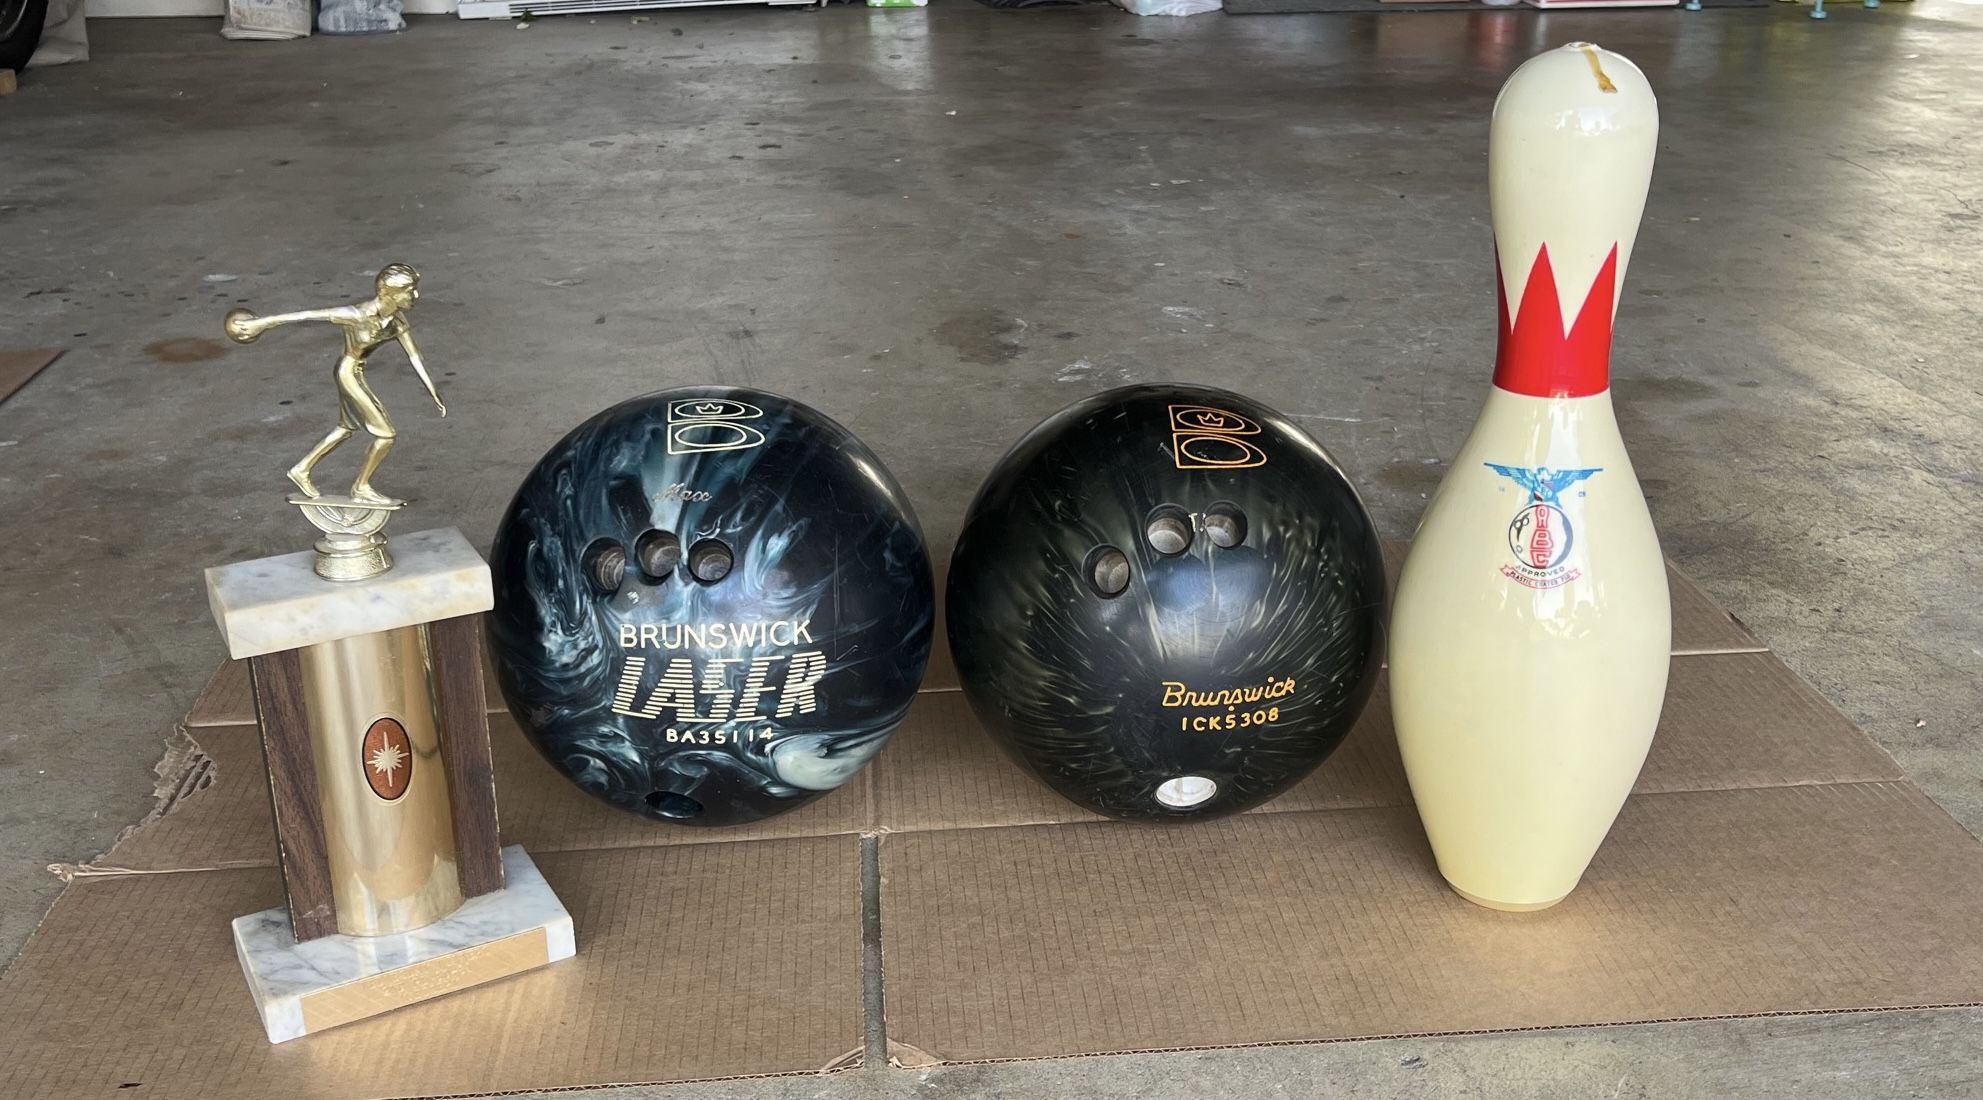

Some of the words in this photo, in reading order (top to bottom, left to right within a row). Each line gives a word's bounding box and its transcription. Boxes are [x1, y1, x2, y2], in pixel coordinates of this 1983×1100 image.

[1516, 565, 1565, 577] APPROVED
[620, 620, 813, 649] BRUNSWICK
[611, 650, 827, 722] LASER
[1162, 676, 1296, 707] Brunswick
